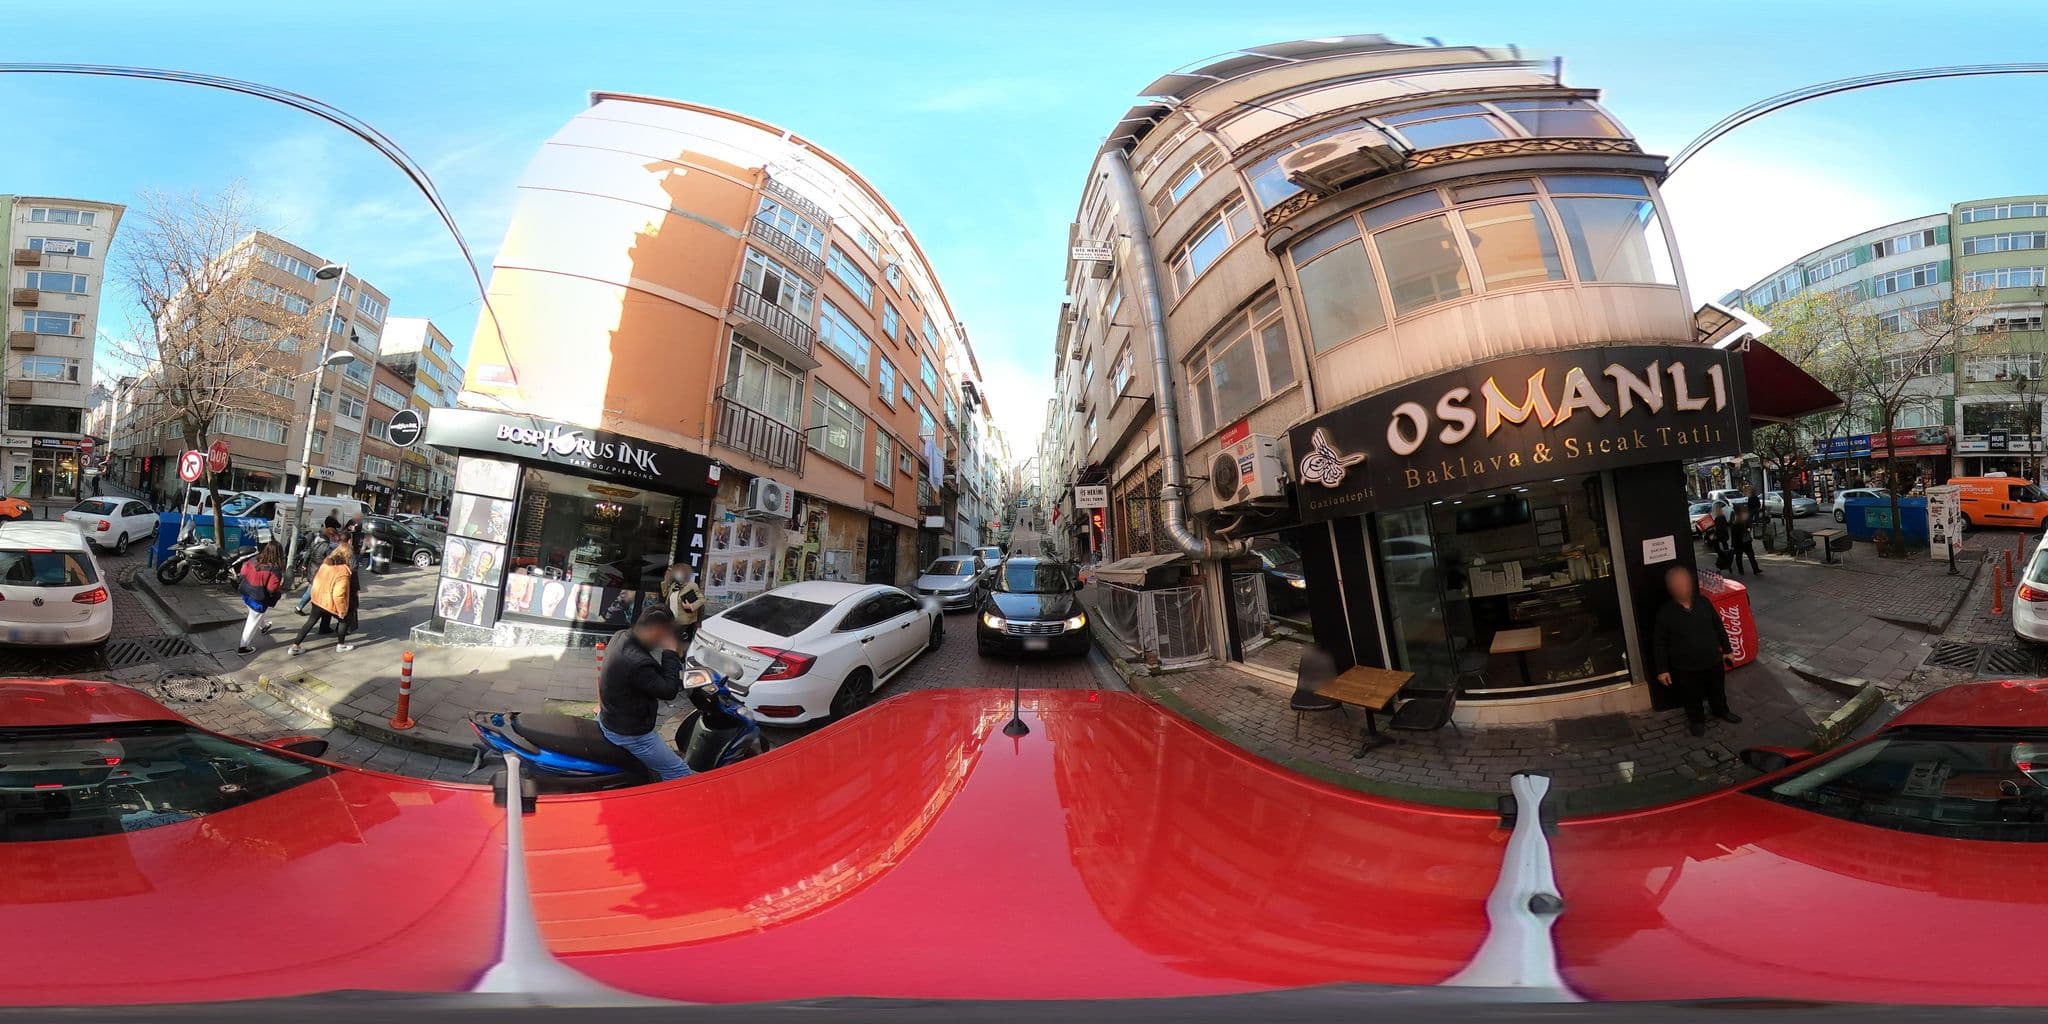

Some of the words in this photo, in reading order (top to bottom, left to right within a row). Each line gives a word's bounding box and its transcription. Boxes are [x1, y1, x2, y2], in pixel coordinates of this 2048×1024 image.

[1387, 359, 1727, 455] OSMANLI
[210, 449, 228, 465] DUR
[497, 424, 614, 460] BOSPHORUS
[617, 441, 663, 476] INK
[1404, 450, 1522, 489] Baklava
[1533, 443, 1554, 465] &
[1564, 428, 1649, 460] Sıcak
[1656, 424, 1722, 448] Tatlı
[1310, 487, 1375, 510] Gaziantepli
